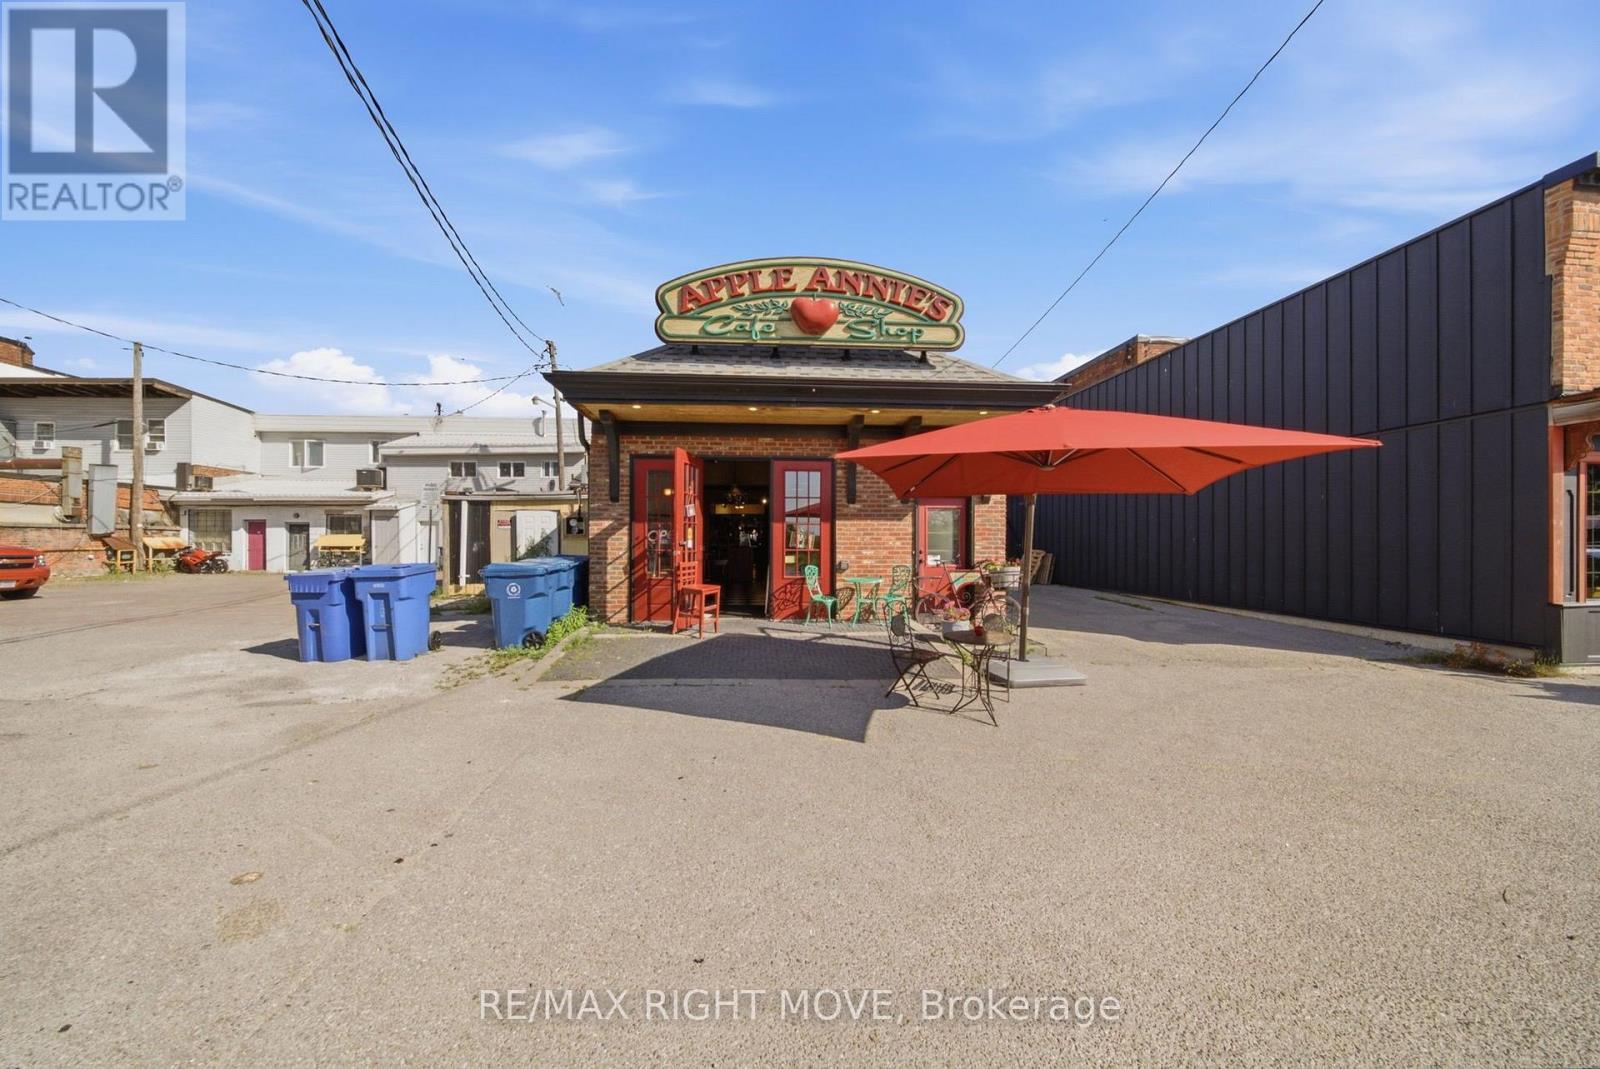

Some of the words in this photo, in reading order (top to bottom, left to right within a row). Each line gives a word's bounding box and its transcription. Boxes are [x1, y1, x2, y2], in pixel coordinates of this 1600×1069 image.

[680, 267, 798, 314] APPLE
[804, 266, 955, 321] ANNIE'S
[847, 317, 925, 343] Shop
